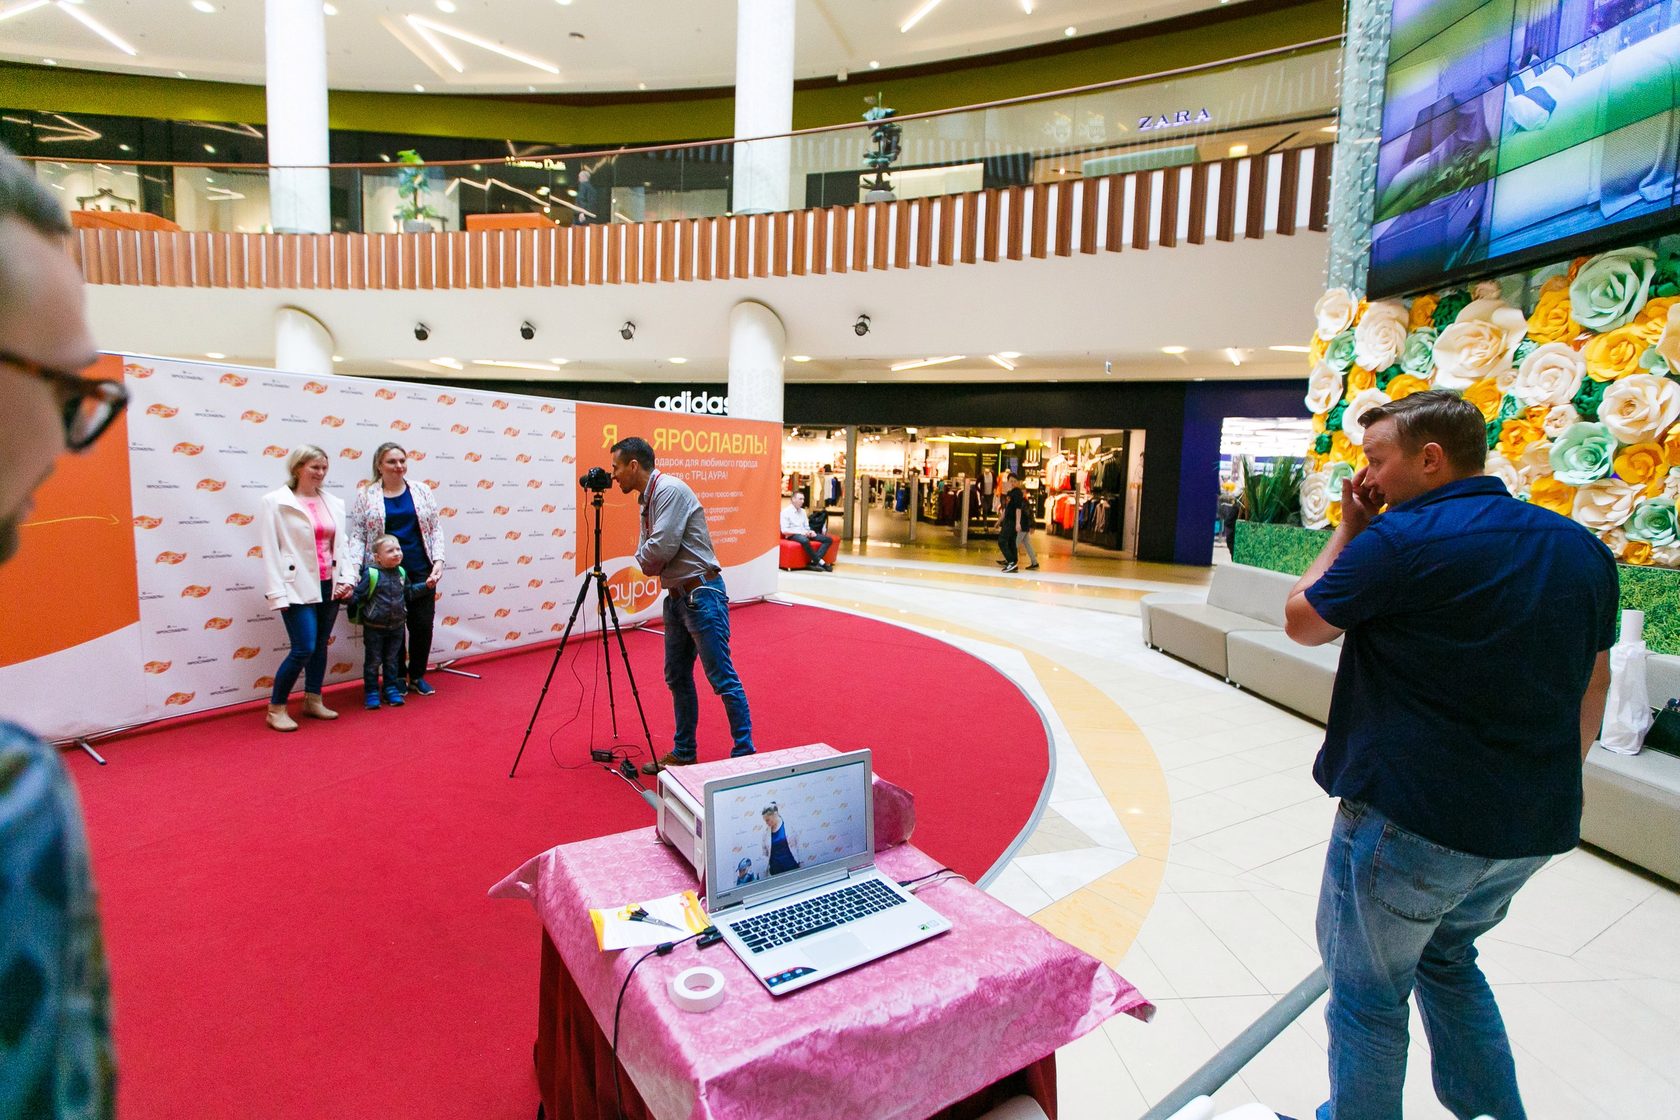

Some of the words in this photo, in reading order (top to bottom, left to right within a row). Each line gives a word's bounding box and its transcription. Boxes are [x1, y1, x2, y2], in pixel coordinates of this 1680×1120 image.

[1137, 107, 1213, 132] ZARA
[601, 424, 618, 448] Я
[653, 428, 768, 455] ЯРОСЛАВЛЬ!
[654, 457, 684, 468] одарок
[684, 459, 699, 468] для
[700, 457, 734, 469] любимого
[735, 460, 758, 470] города
[691, 470, 707, 481] ТРЦ
[608, 578, 658, 608] аура
